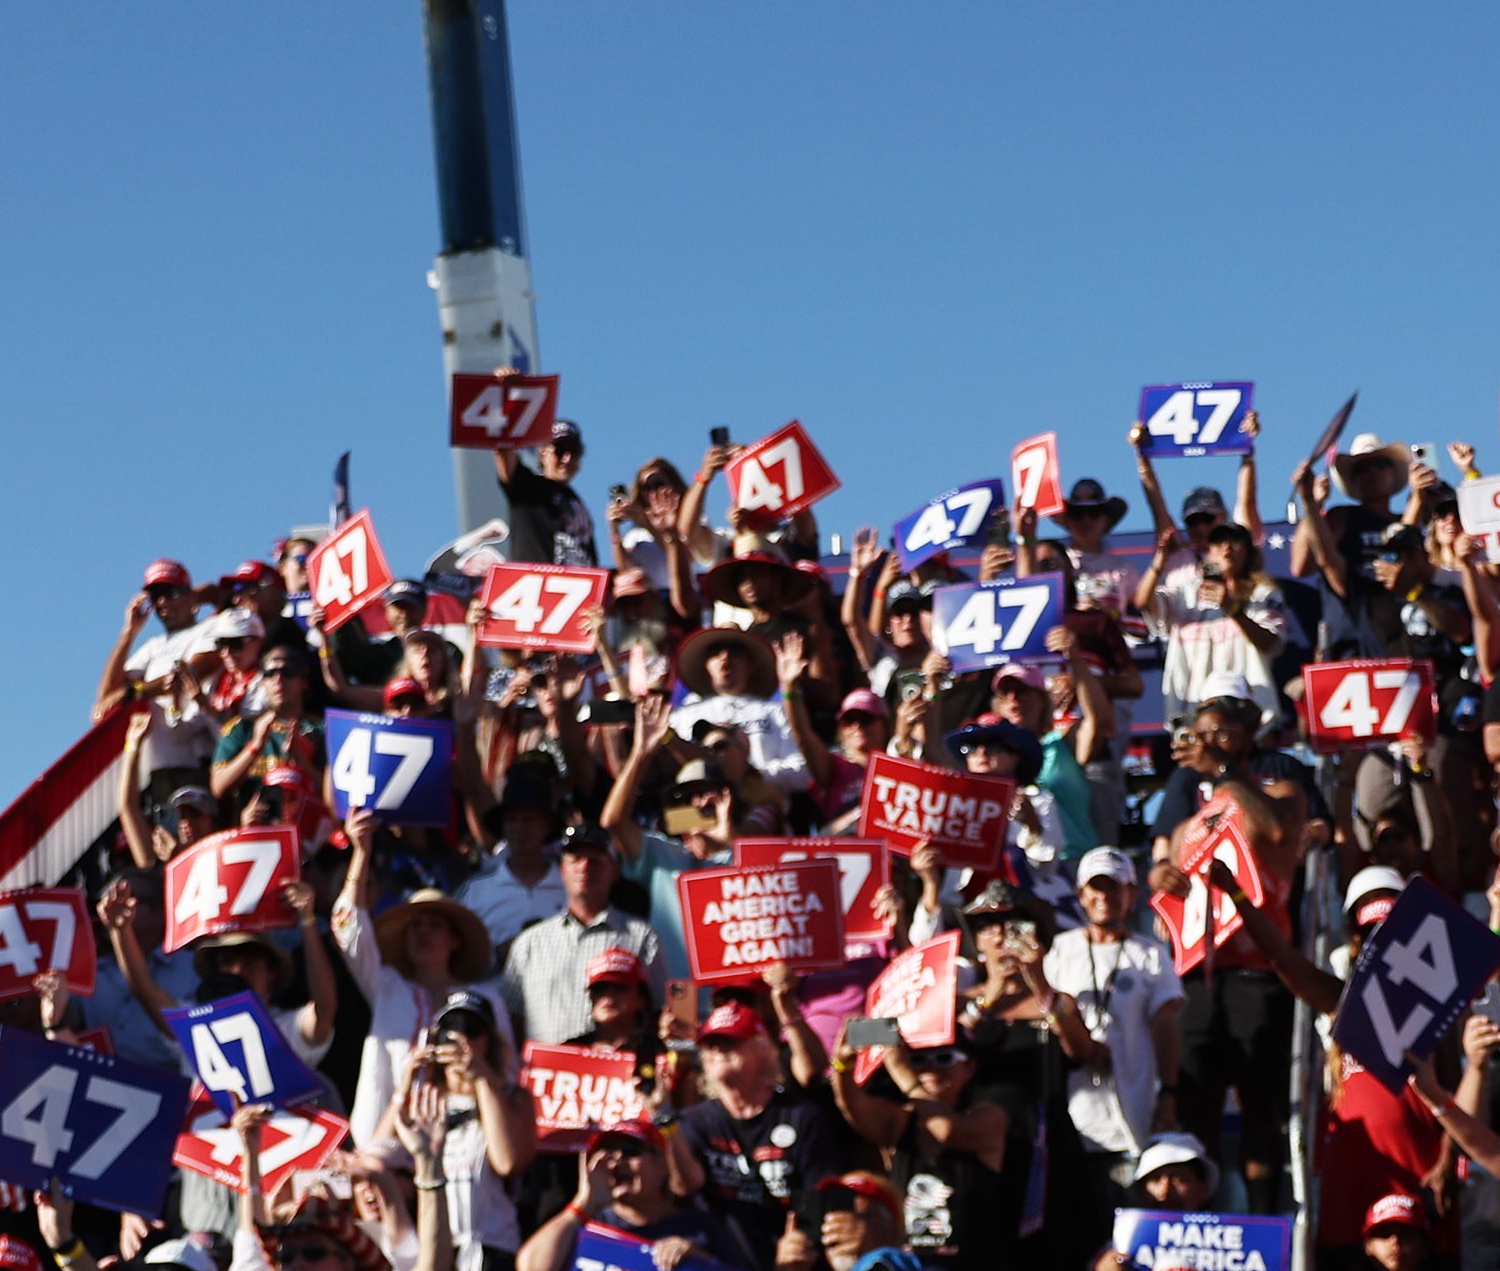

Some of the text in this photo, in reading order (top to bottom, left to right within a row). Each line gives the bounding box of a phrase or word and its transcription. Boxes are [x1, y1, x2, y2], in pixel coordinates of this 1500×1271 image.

[462, 387, 547, 437] 47
[1148, 389, 1241, 444] 47
[737, 438, 804, 511] 47
[1015, 447, 1047, 507] 7
[905, 488, 993, 551] 47
[316, 526, 367, 607] 47
[492, 574, 593, 634] 47
[946, 585, 1050, 653] 47
[1320, 672, 1422, 736] 47
[333, 731, 433, 809] 47
[874, 776, 1001, 821] TRUMP
[883, 801, 983, 841] VANCE
[176, 841, 282, 924] 47
[703, 894, 822, 924] AMERICA
[722, 871, 798, 897] MAKE
[720, 917, 808, 942] GREAT
[722, 938, 814, 966] AGAIN!
[1362, 913, 1459, 1068] 47
[190, 1012, 275, 1103] 47
[530, 1068, 640, 1105] TRUM
[2, 1065, 162, 1180] 47
[541, 1095, 643, 1124] VANCE
[191, 1109, 327, 1176] 47
[1158, 1222, 1243, 1249] MAKE
